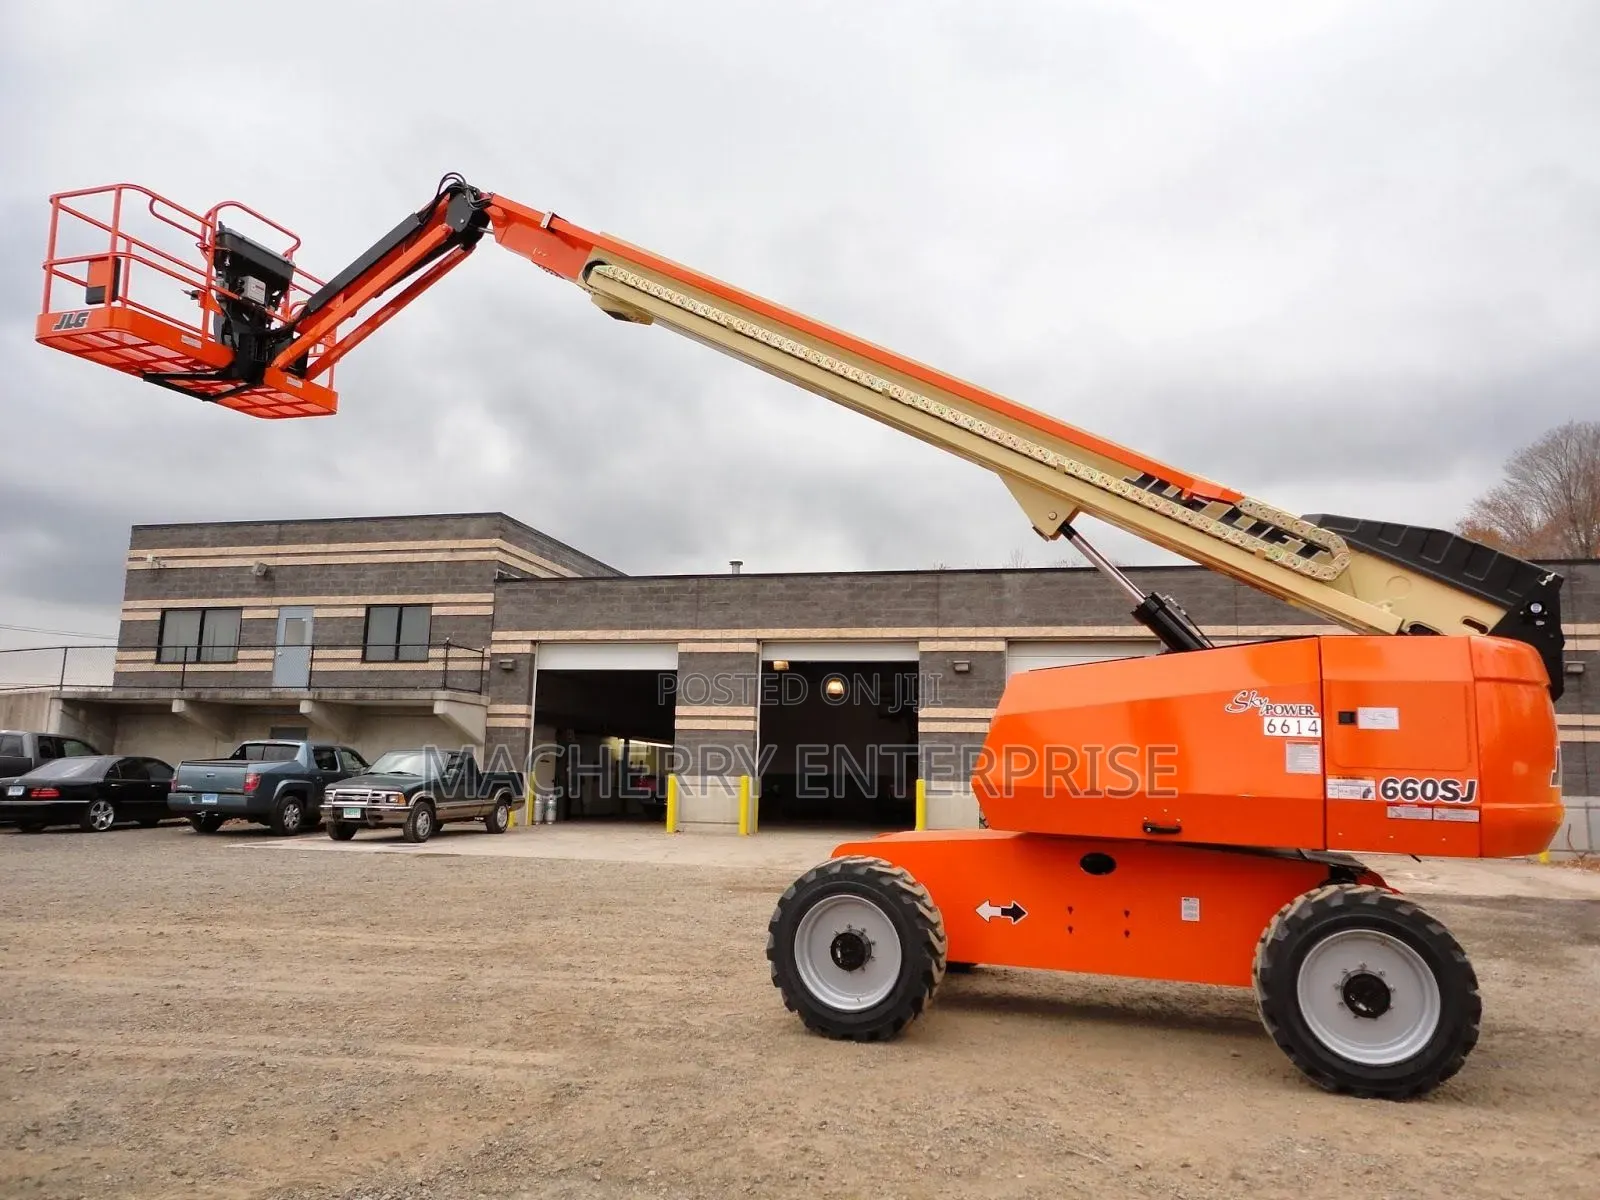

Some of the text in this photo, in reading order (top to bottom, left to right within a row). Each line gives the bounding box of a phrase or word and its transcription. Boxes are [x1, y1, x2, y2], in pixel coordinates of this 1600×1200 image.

[53, 311, 90, 331] JLG
[1225, 690, 1315, 716] Sky POWER
[1266, 718, 1319, 735] 6614
[1380, 777, 1477, 803] 660SJ
